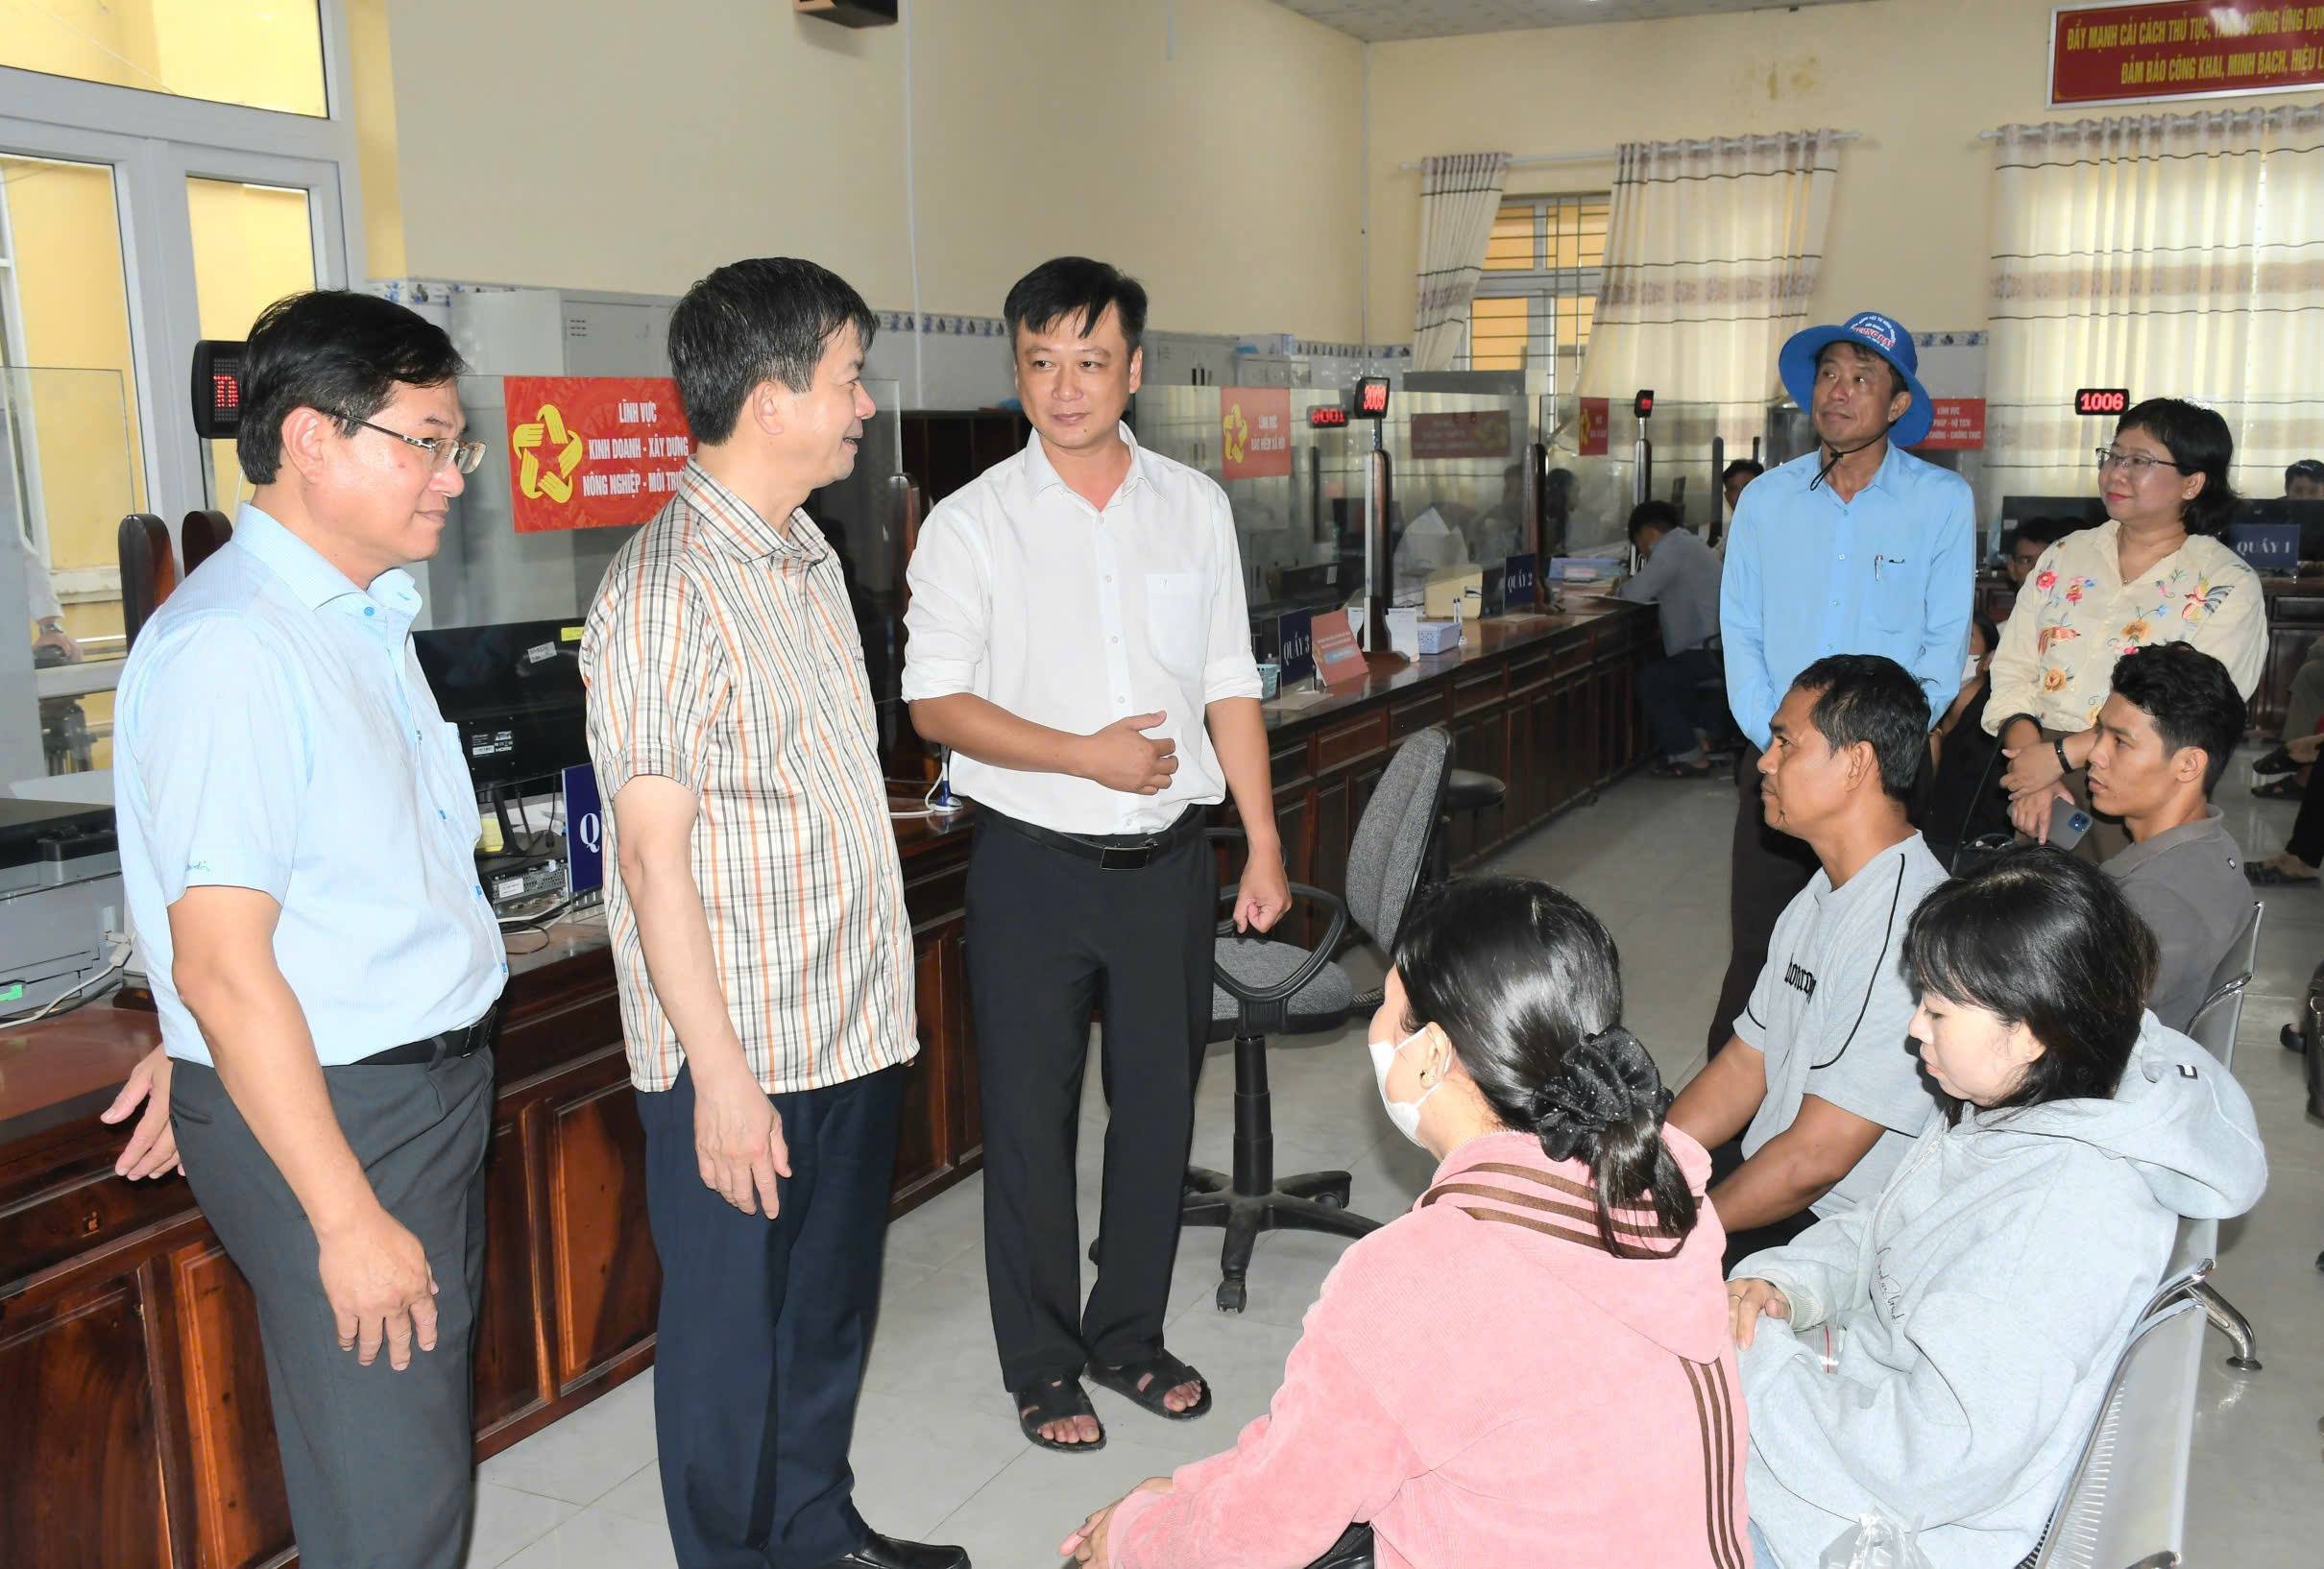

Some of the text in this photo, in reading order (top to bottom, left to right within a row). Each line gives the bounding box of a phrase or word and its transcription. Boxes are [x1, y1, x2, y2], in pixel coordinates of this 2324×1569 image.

[2088, 24, 2118, 53] MẠNH
[2119, 15, 2137, 46] CẢI
[2139, 16, 2167, 44] CÁCH
[2168, 54, 2196, 82] CÔNG
[2227, 52, 2256, 77] MINH
[618, 398, 657, 426] LĨNH VỰC
[2079, 392, 2124, 411] 1006
[589, 439, 611, 460] KINH
[612, 438, 642, 459] DOANH
[647, 434, 665, 458] XÂY
[666, 436, 689, 461] DỰNG
[583, 471, 608, 496] NÔNG
[609, 470, 641, 498] NGHIỆP
[648, 469, 666, 492] MÔI
[2284, 541, 2290, 554] 1
[580, 811, 601, 853] Q
